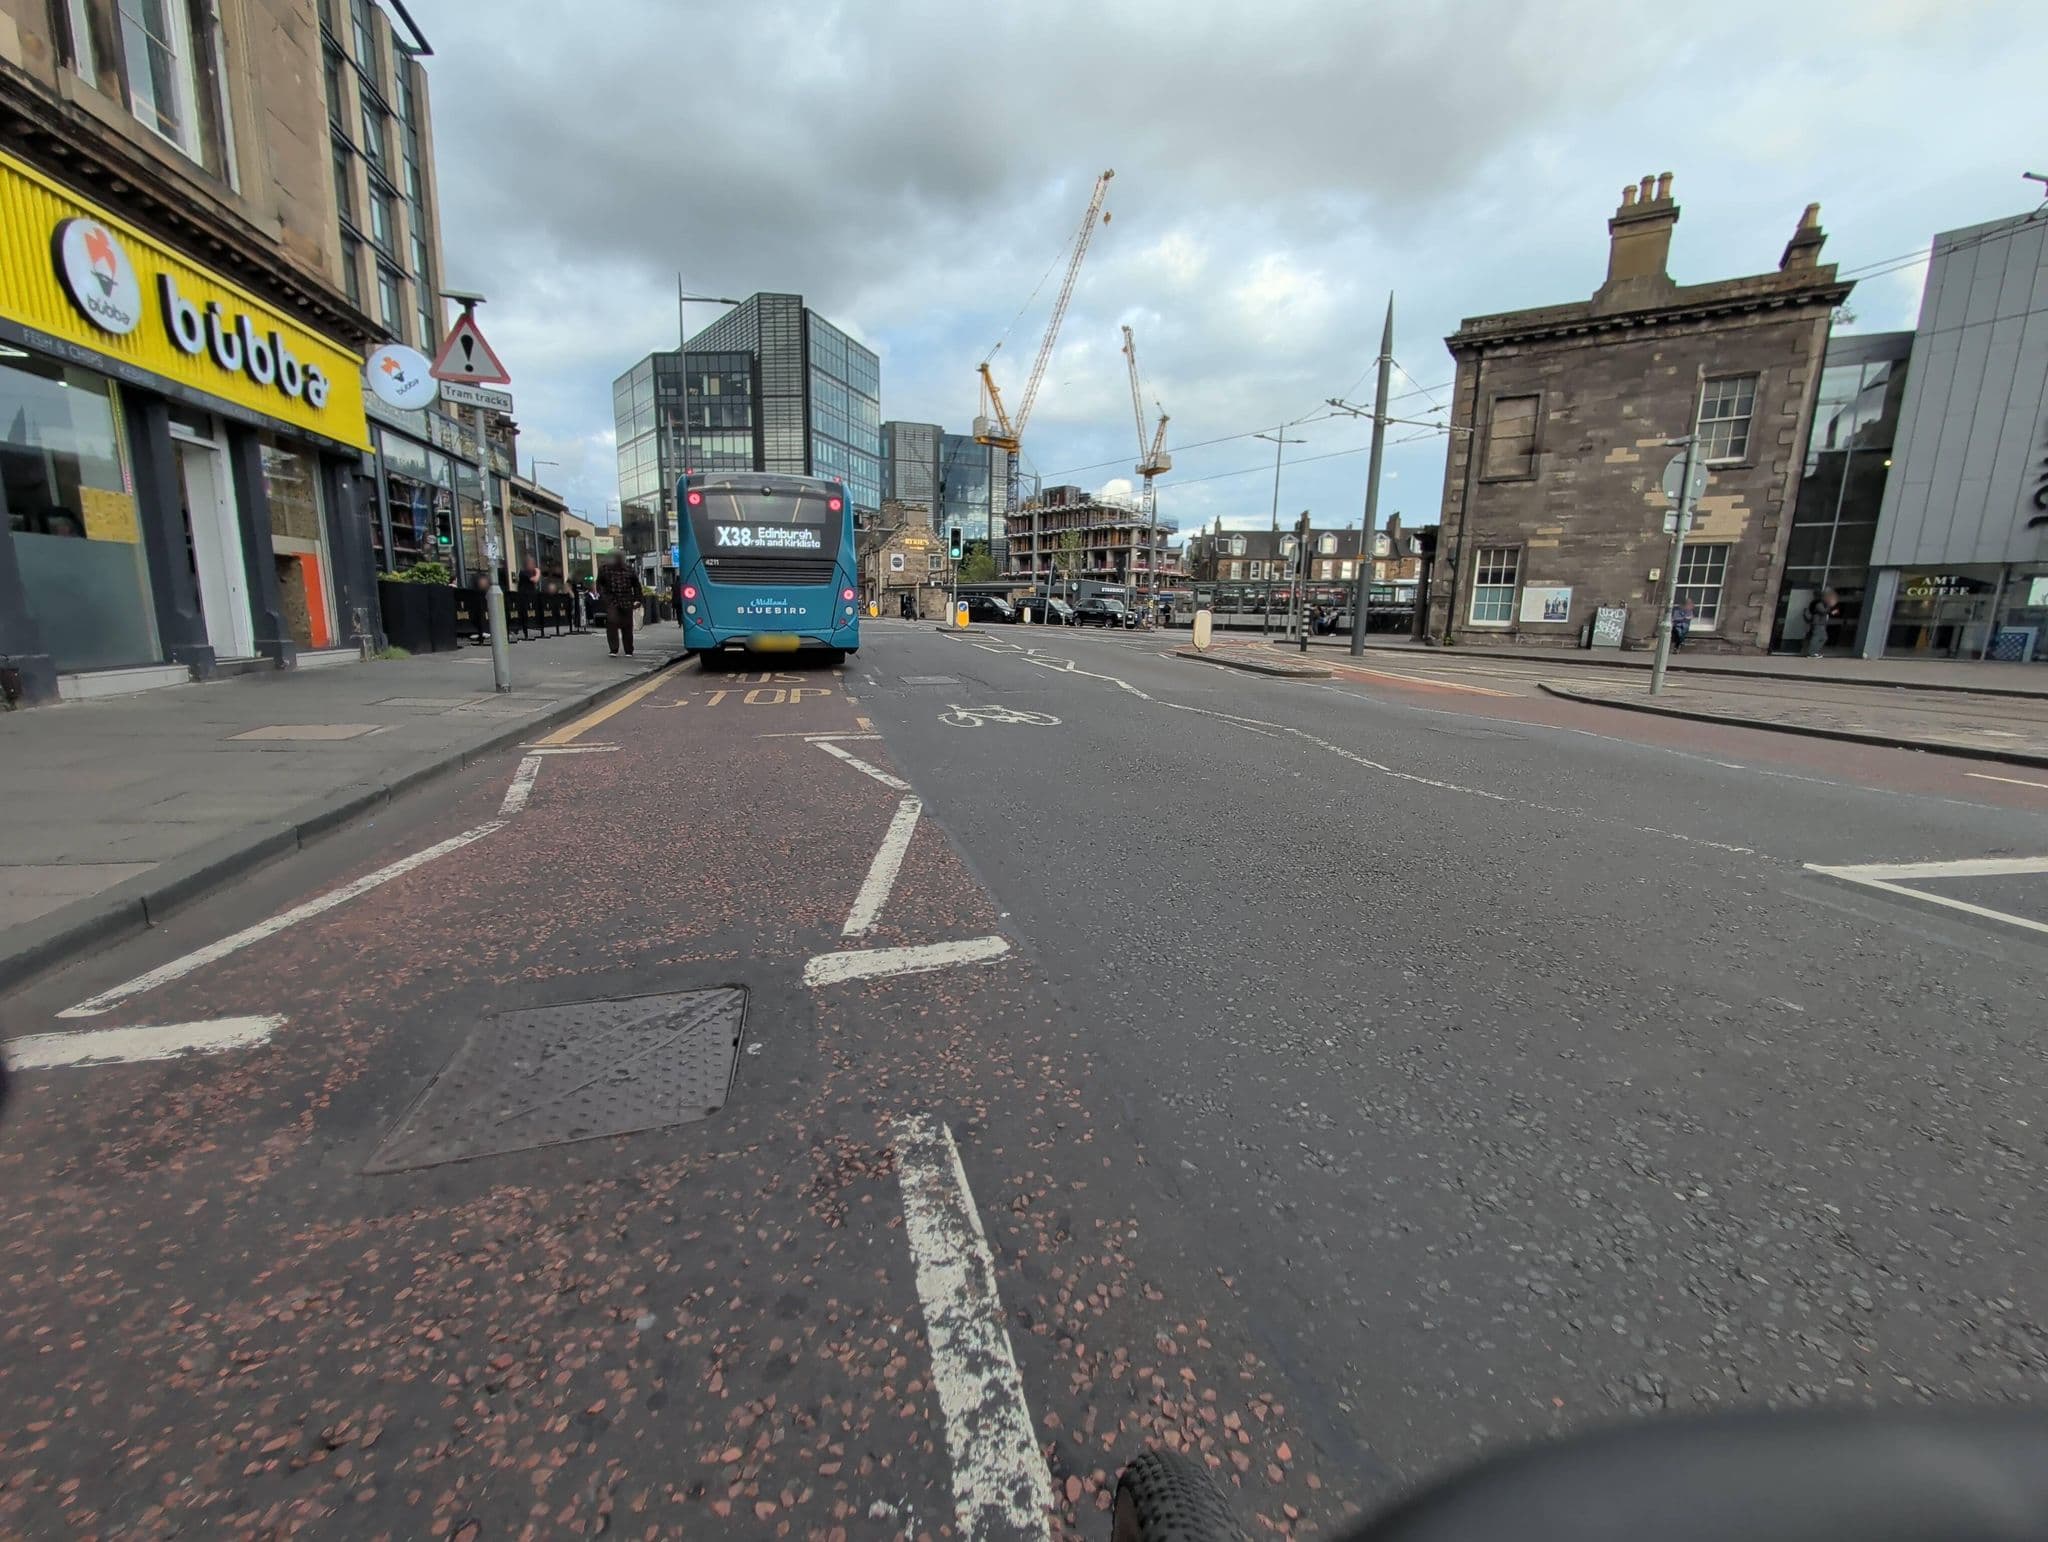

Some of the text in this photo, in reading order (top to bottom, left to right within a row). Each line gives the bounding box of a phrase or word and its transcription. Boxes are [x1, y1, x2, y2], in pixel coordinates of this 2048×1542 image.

[444, 385, 509, 408] Tram tracks
[717, 526, 813, 547] X38 Edinburgh
[767, 539, 783, 547] and
[1921, 576, 1960, 586] AMT
[1906, 586, 1971, 597] COFFEE
[736, 605, 807, 615] BLUEBIRD
